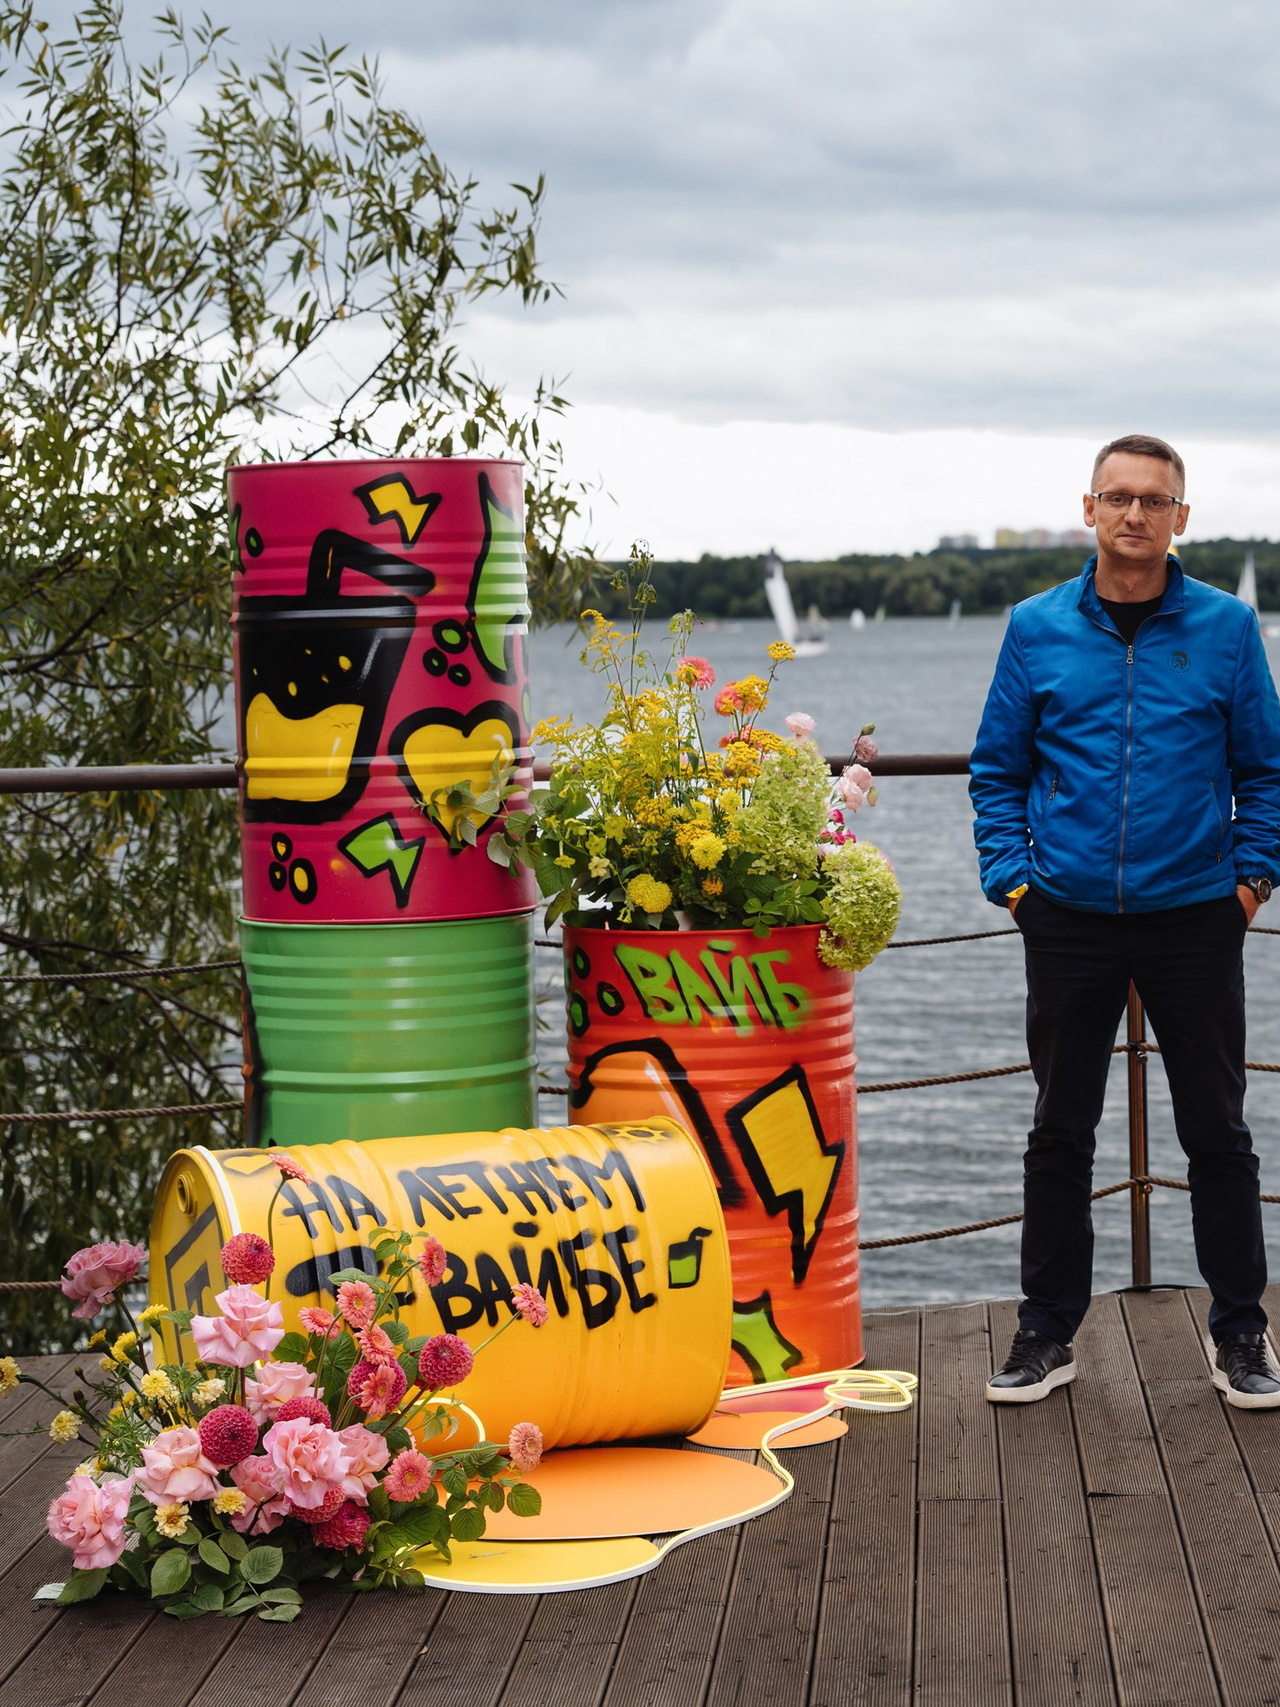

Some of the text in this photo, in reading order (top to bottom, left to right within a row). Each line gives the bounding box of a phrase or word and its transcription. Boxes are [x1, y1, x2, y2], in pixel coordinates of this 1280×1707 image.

[614, 939, 812, 1037] ВАЙБ
[277, 1150, 646, 1240] НА ЛЕТНЕМ
[427, 1221, 659, 1335] ВАЙБЕ
